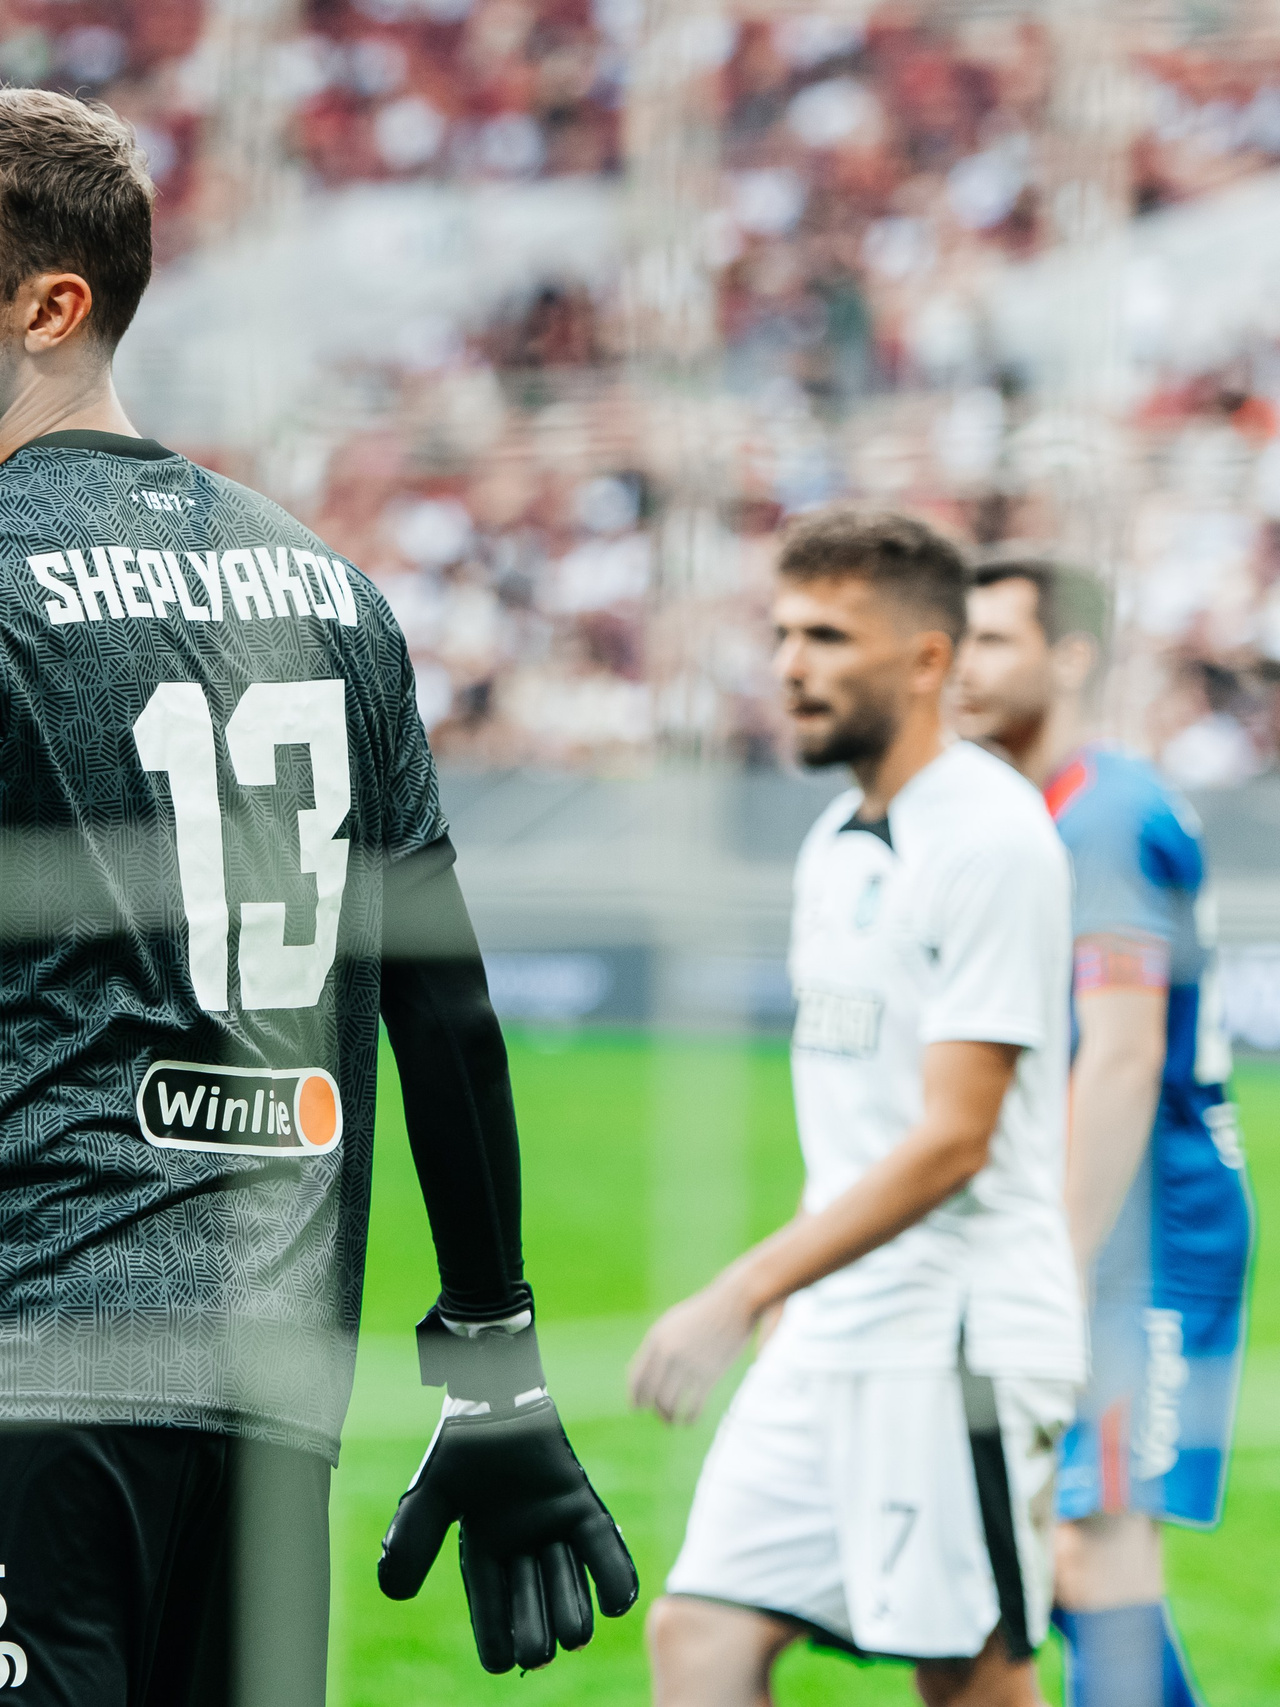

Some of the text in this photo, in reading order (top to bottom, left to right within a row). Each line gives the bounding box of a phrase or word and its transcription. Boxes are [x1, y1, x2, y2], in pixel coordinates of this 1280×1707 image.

[141, 489, 182, 511] 1937
[26, 546, 358, 628] SHEPLYAKOV
[132, 679, 351, 1012] 13
[157, 1080, 292, 1136] Winlie
[880, 1500, 919, 1575] 7
